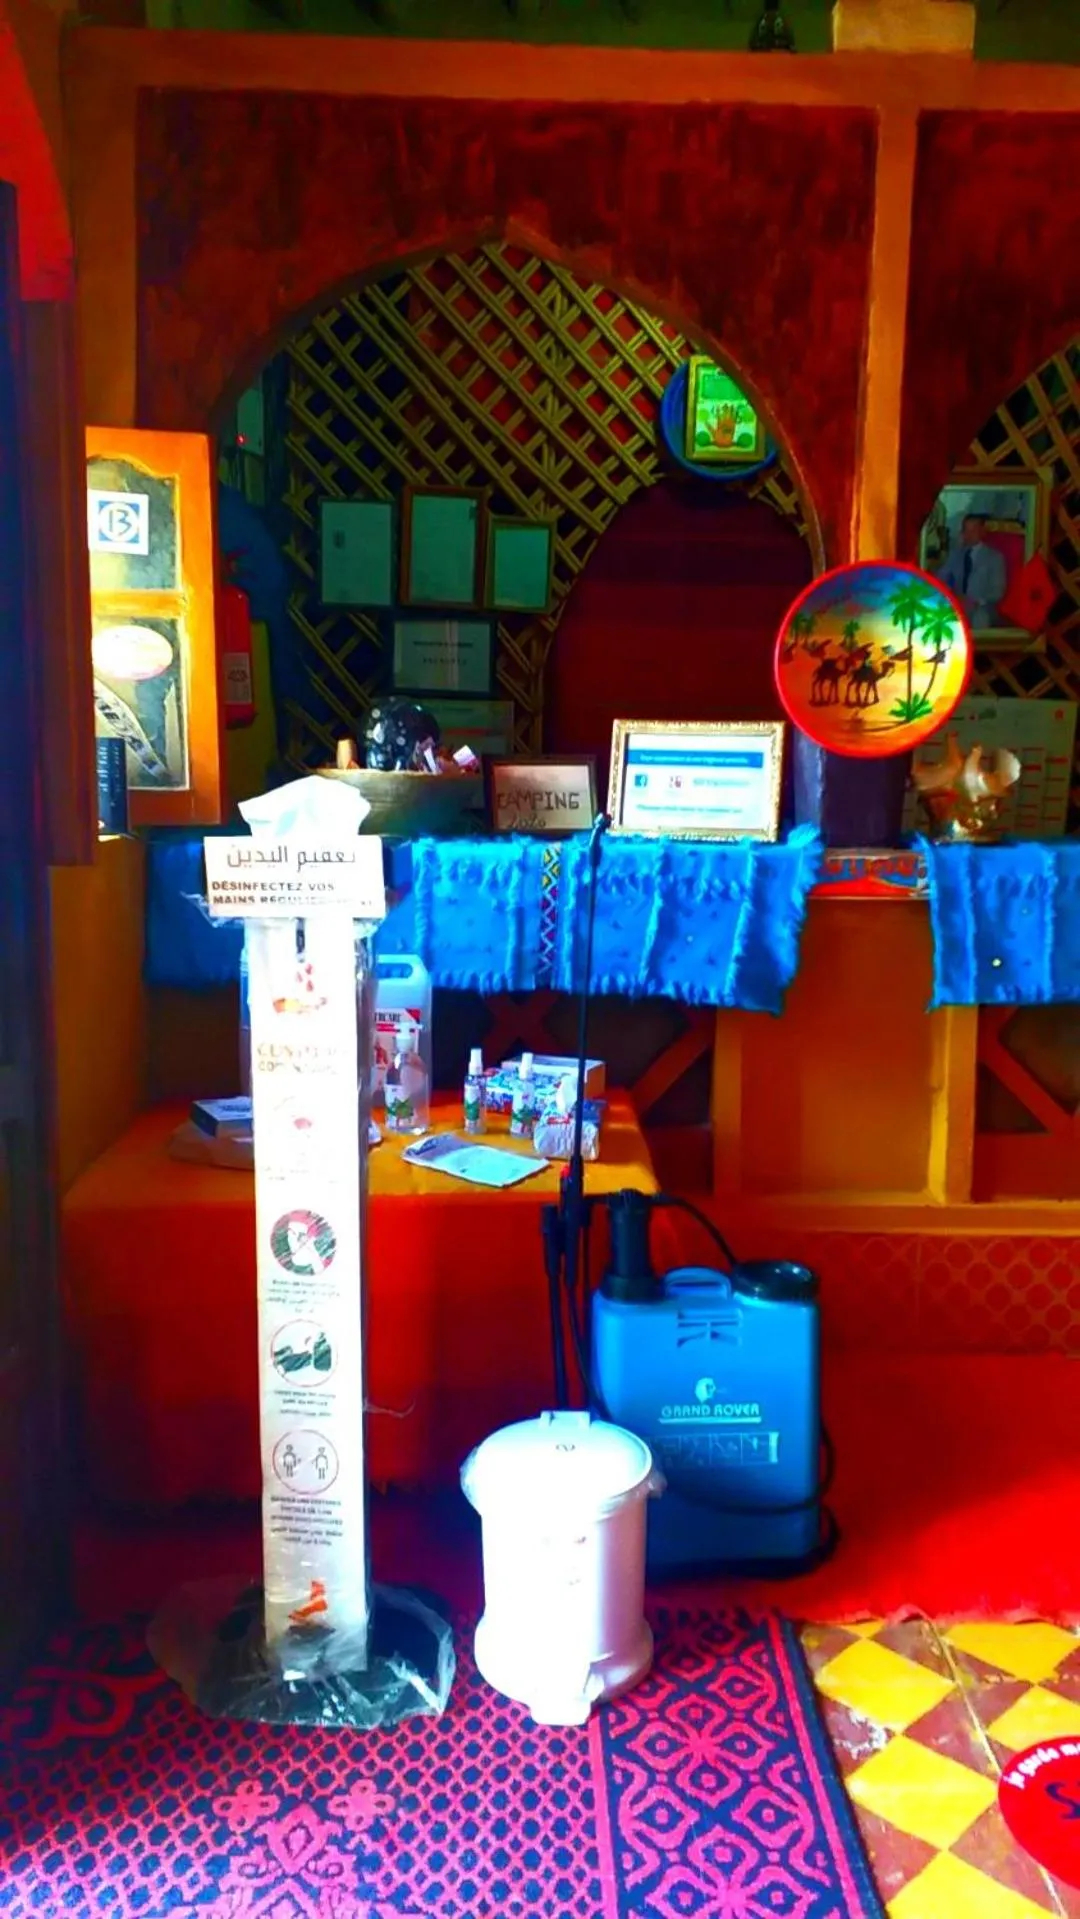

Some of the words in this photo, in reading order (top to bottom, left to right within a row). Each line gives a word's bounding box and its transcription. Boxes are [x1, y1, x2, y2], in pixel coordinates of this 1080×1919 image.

[497, 791, 580, 810] CAMPING
[227, 843, 288, 868] اليدين
[213, 895, 256, 906] MAINS
[661, 1405, 710, 1417] GRAND
[714, 1403, 760, 1416] ROVER
